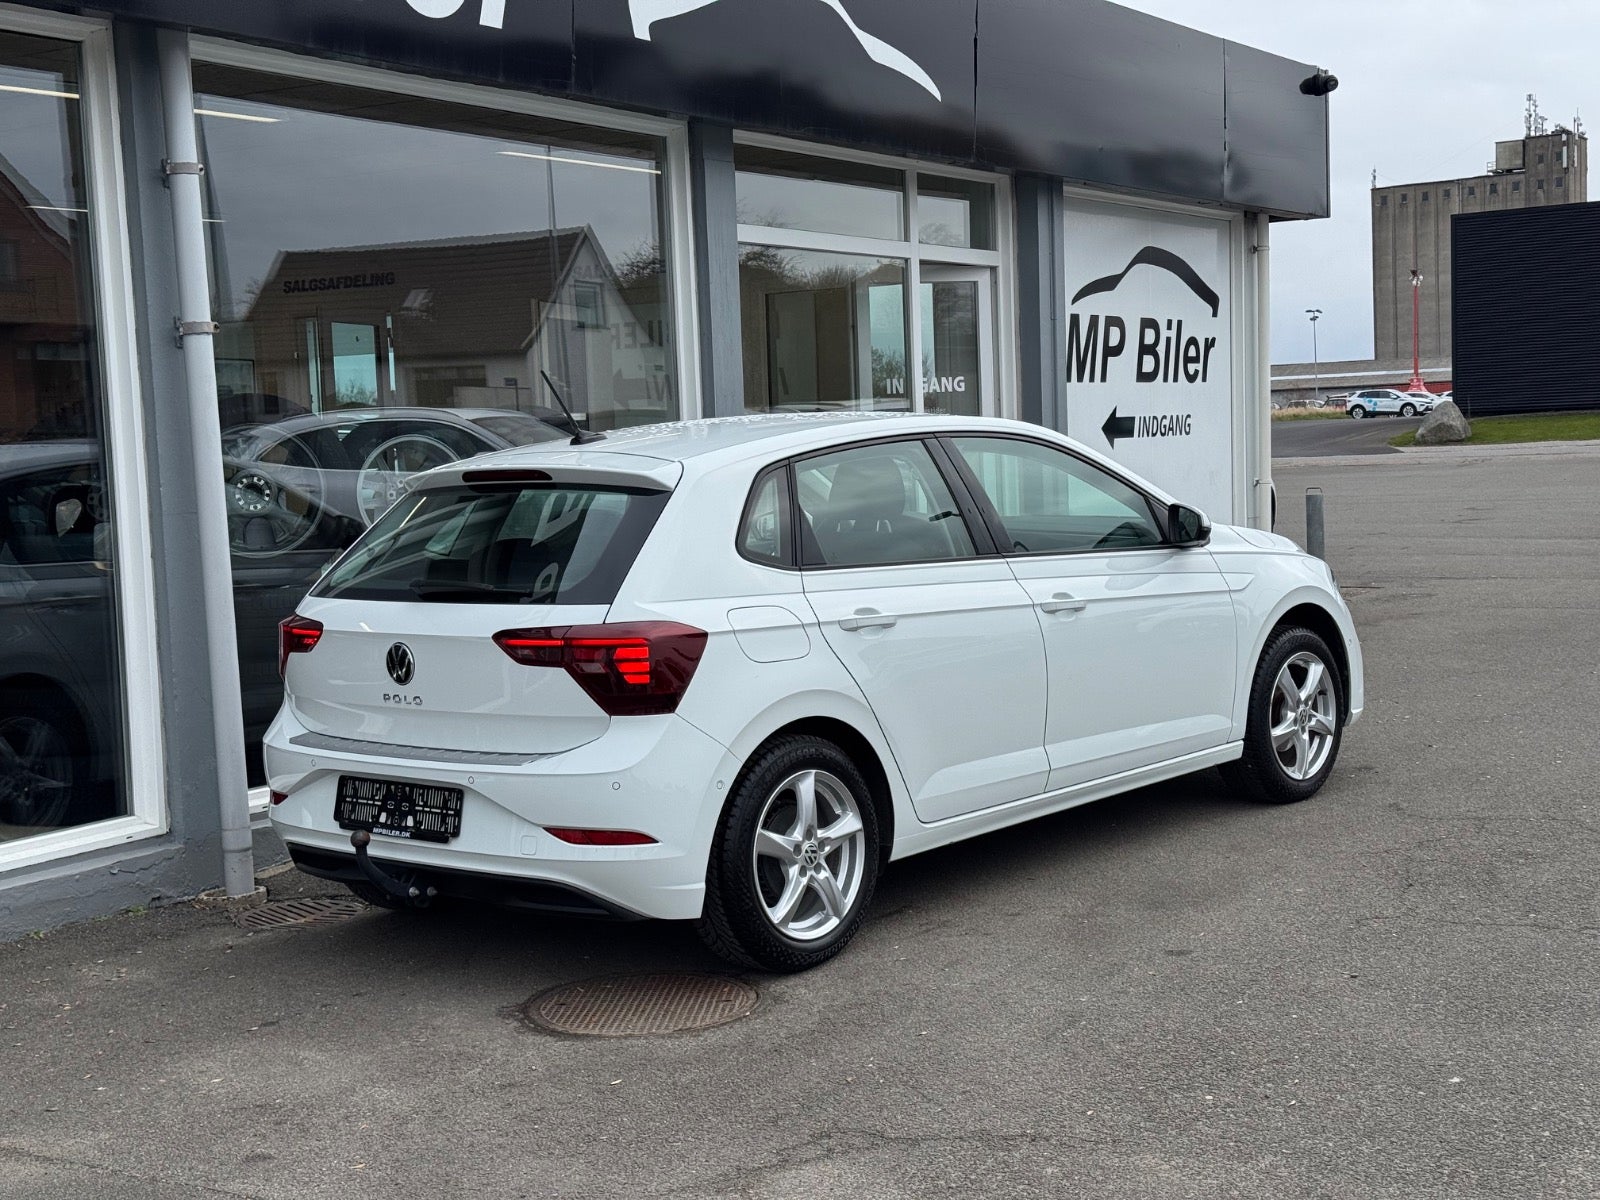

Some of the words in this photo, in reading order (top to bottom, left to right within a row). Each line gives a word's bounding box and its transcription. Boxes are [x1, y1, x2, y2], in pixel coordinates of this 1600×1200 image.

[283, 271, 395, 294] SALGSAFDELING
[1066, 313, 1126, 383] MP
[1136, 317, 1217, 384] Biler
[886, 376, 966, 394] INGANG
[1137, 414, 1191, 438] INDGANG
[383, 693, 424, 706] POLO
[372, 827, 412, 838] MPBILER.DK
